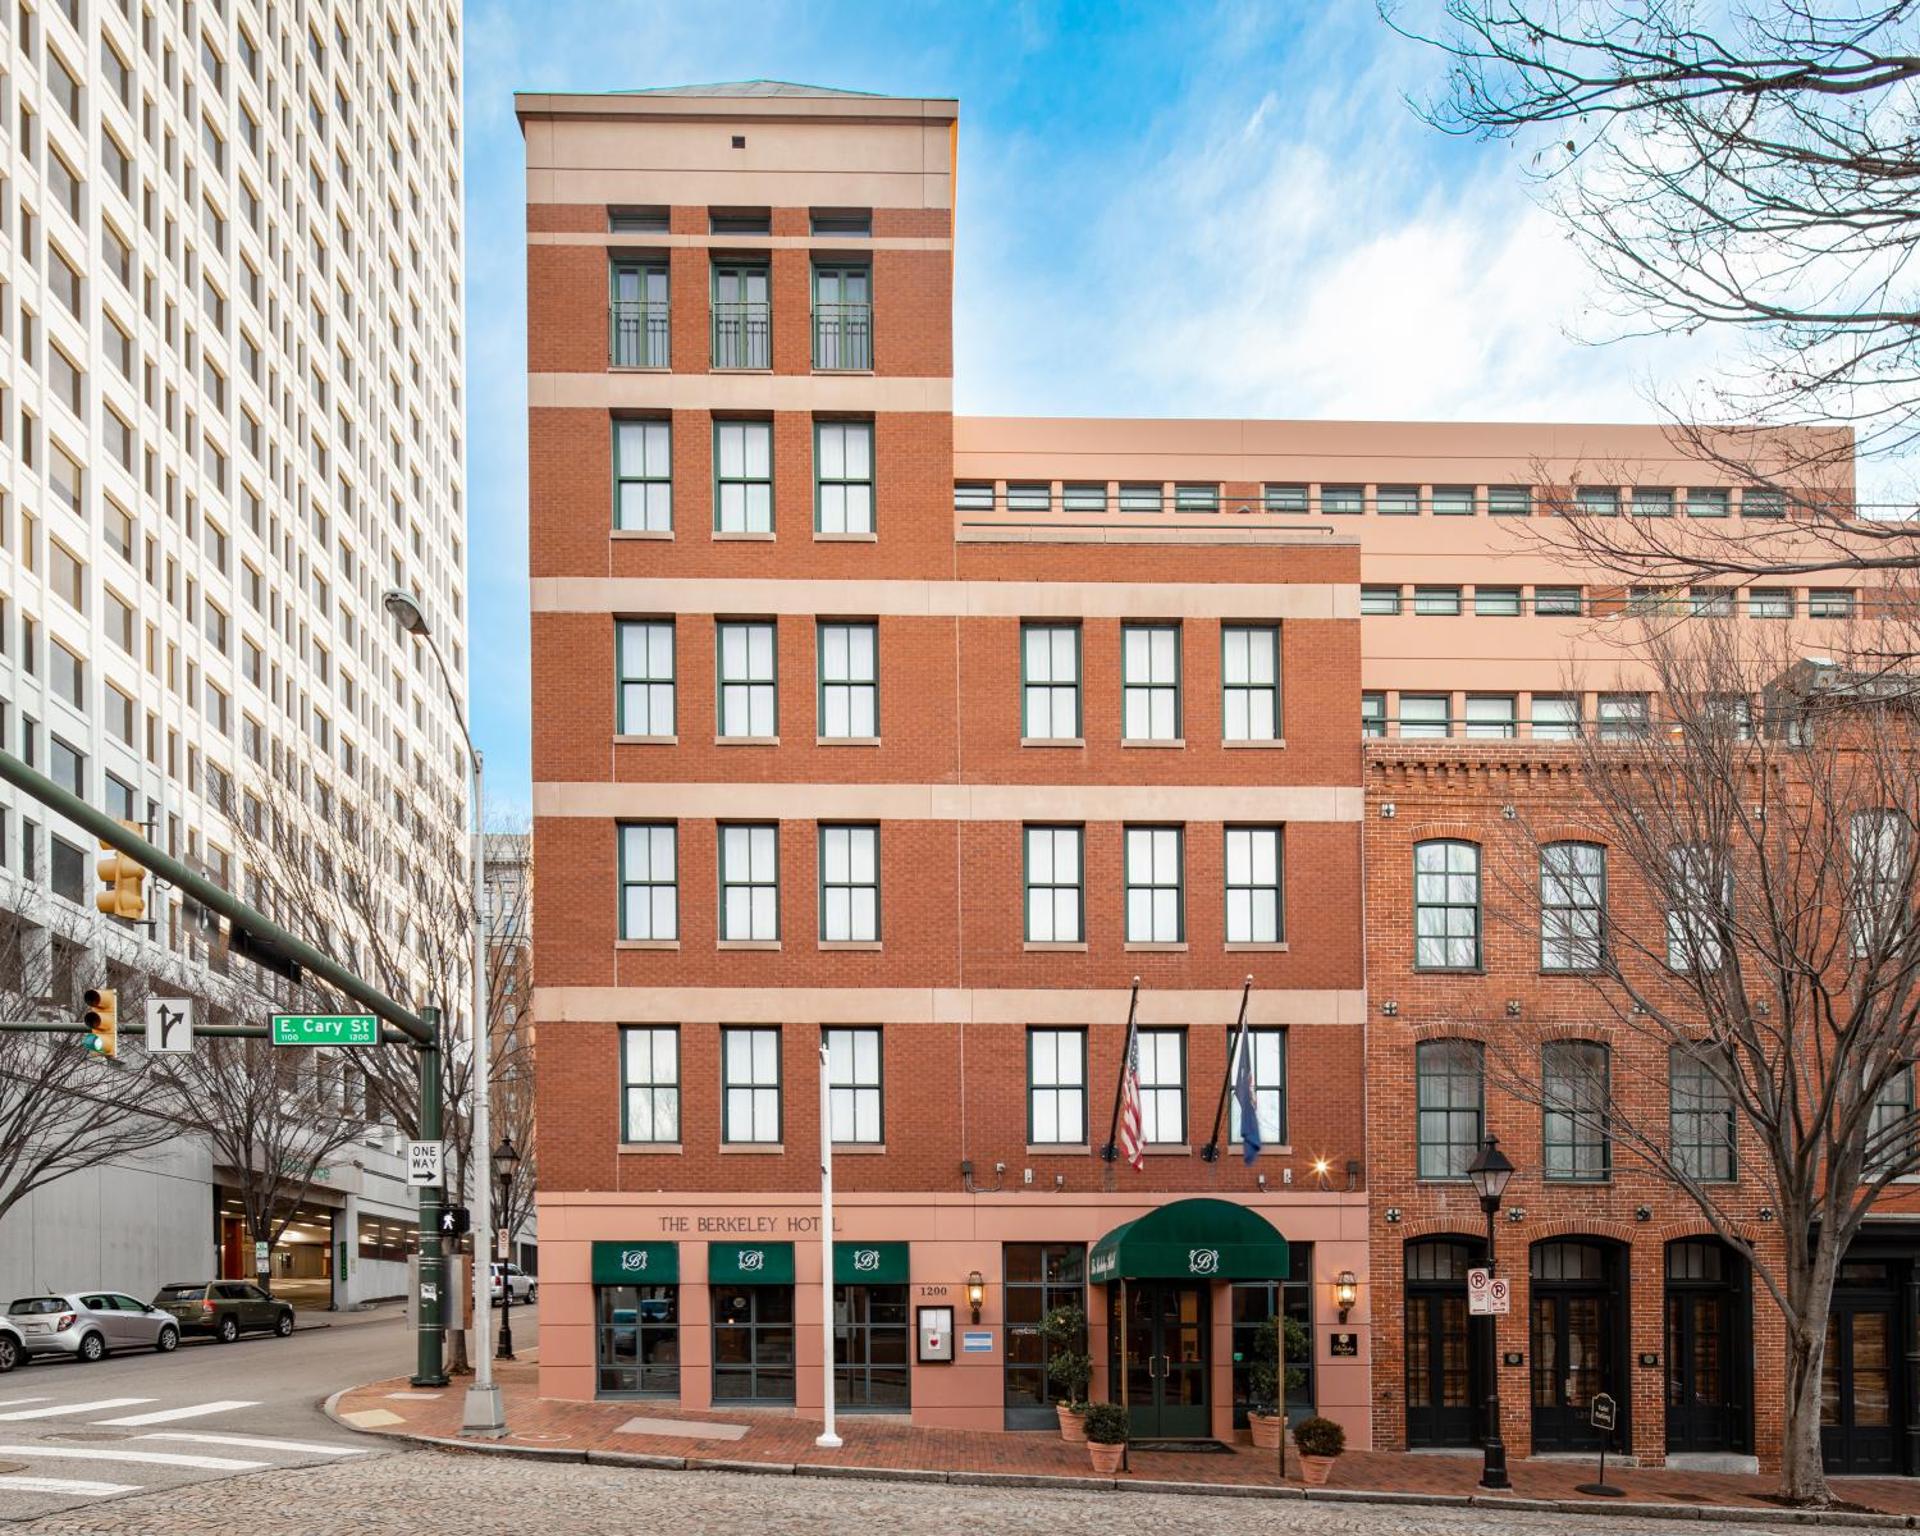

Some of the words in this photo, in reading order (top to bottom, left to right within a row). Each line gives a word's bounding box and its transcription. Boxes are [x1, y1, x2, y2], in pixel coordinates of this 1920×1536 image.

[281, 1019, 296, 1033] E.
[303, 1019, 343, 1036] Cary
[351, 1019, 370, 1033] St
[281, 1033, 299, 1041] 1100
[349, 1033, 370, 1041] 1200
[412, 1146, 437, 1157] ONE
[412, 1158, 437, 1169] WAY
[659, 1216, 690, 1232] THE
[697, 1216, 778, 1232] BERKELEY
[787, 1216, 842, 1232] HOTL
[920, 1286, 947, 1296] 1200
